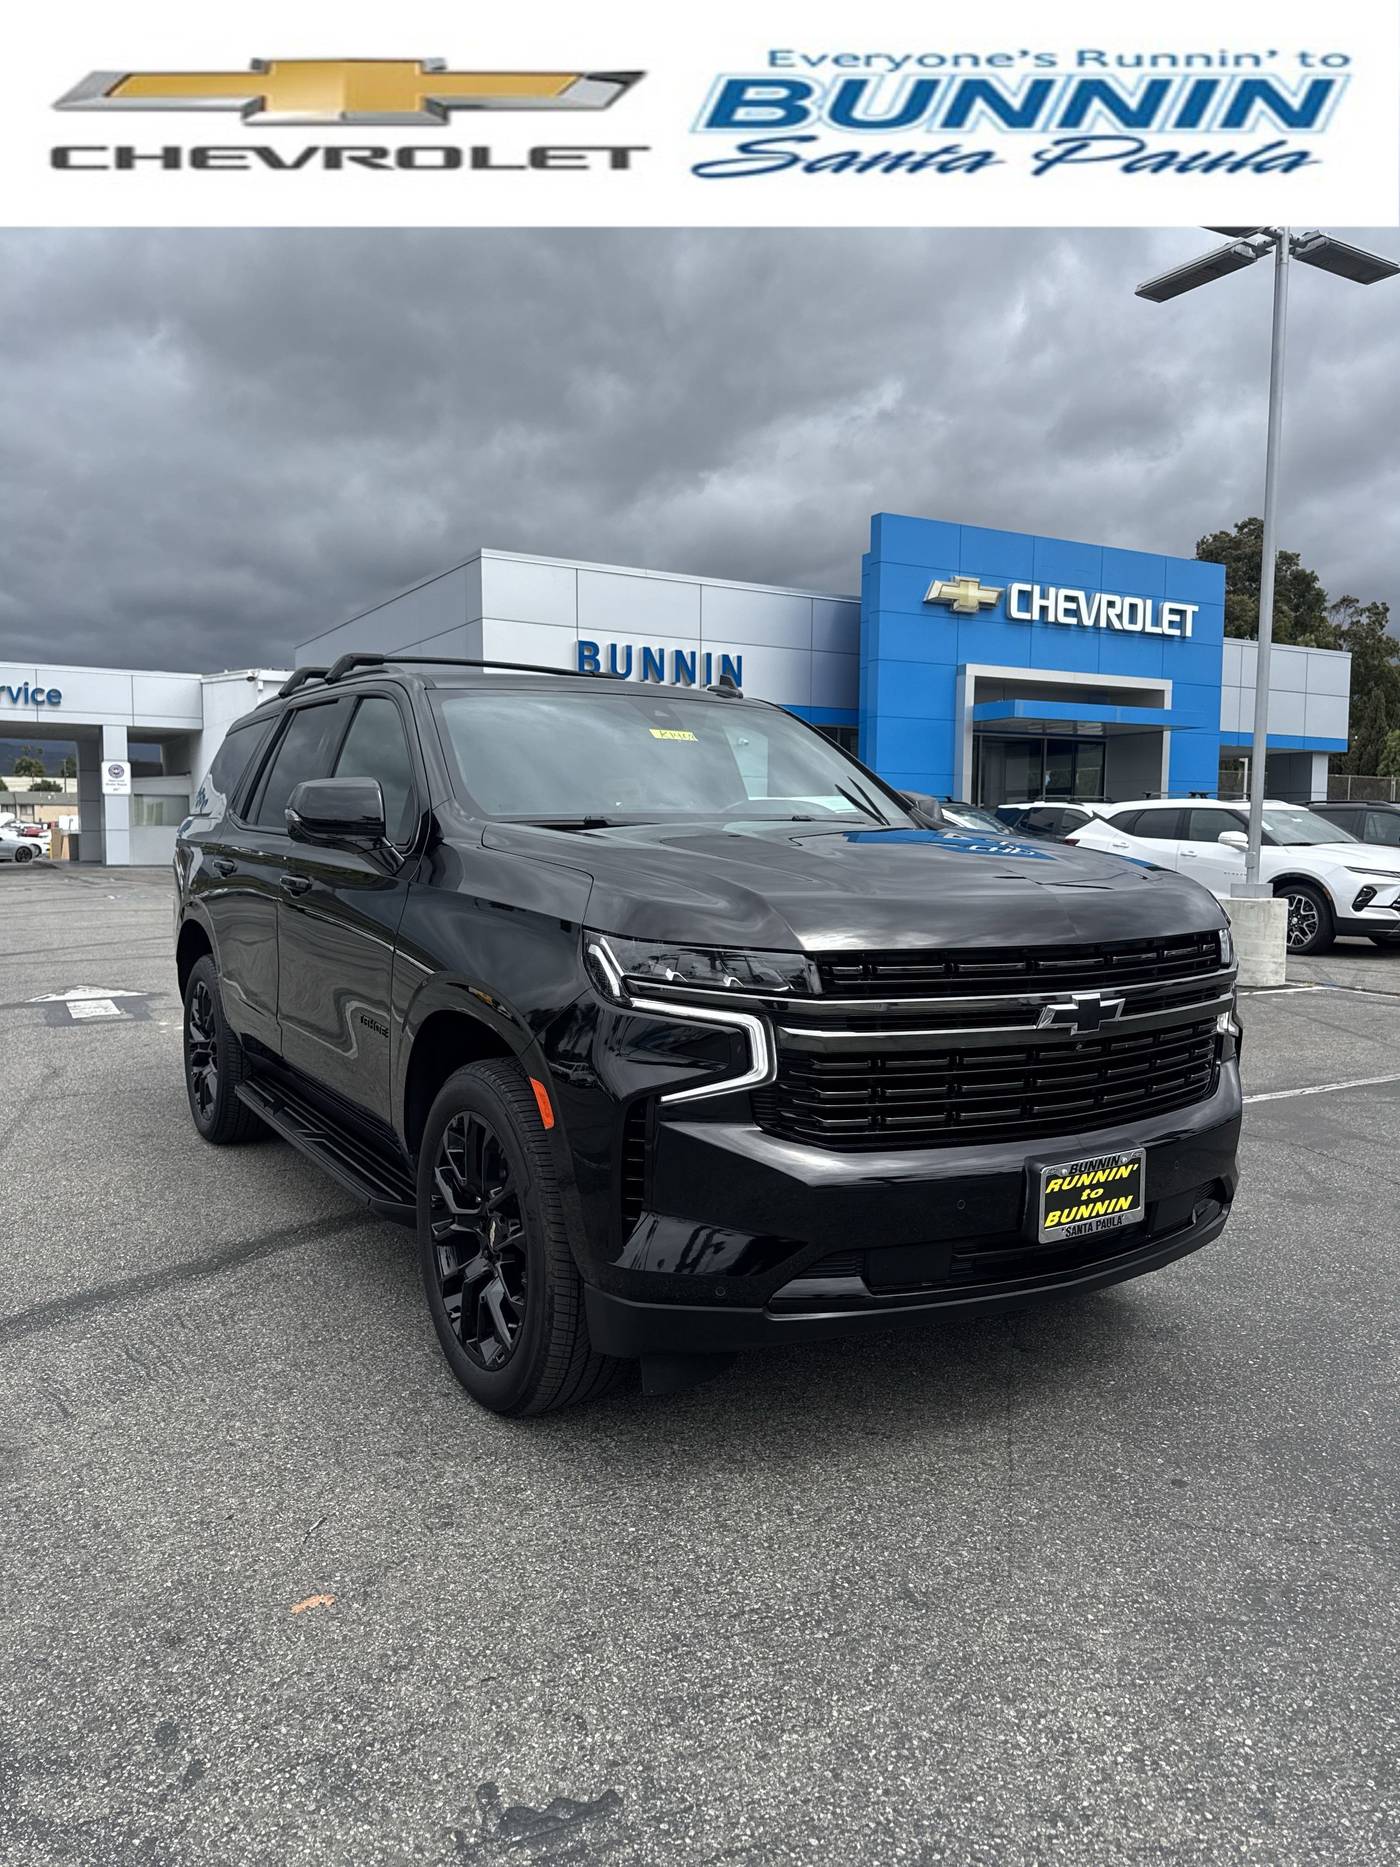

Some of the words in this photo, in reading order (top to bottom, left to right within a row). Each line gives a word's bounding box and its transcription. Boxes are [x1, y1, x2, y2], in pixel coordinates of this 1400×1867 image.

[1008, 582, 1199, 638] CHEVROLET
[576, 640, 743, 688] BUNNIN
[1045, 1164, 1139, 1194] RUNNIN'
[1069, 1155, 1121, 1175] BUNNIN
[1081, 1188, 1104, 1201] to
[1044, 1195, 1133, 1228] BUNNIN
